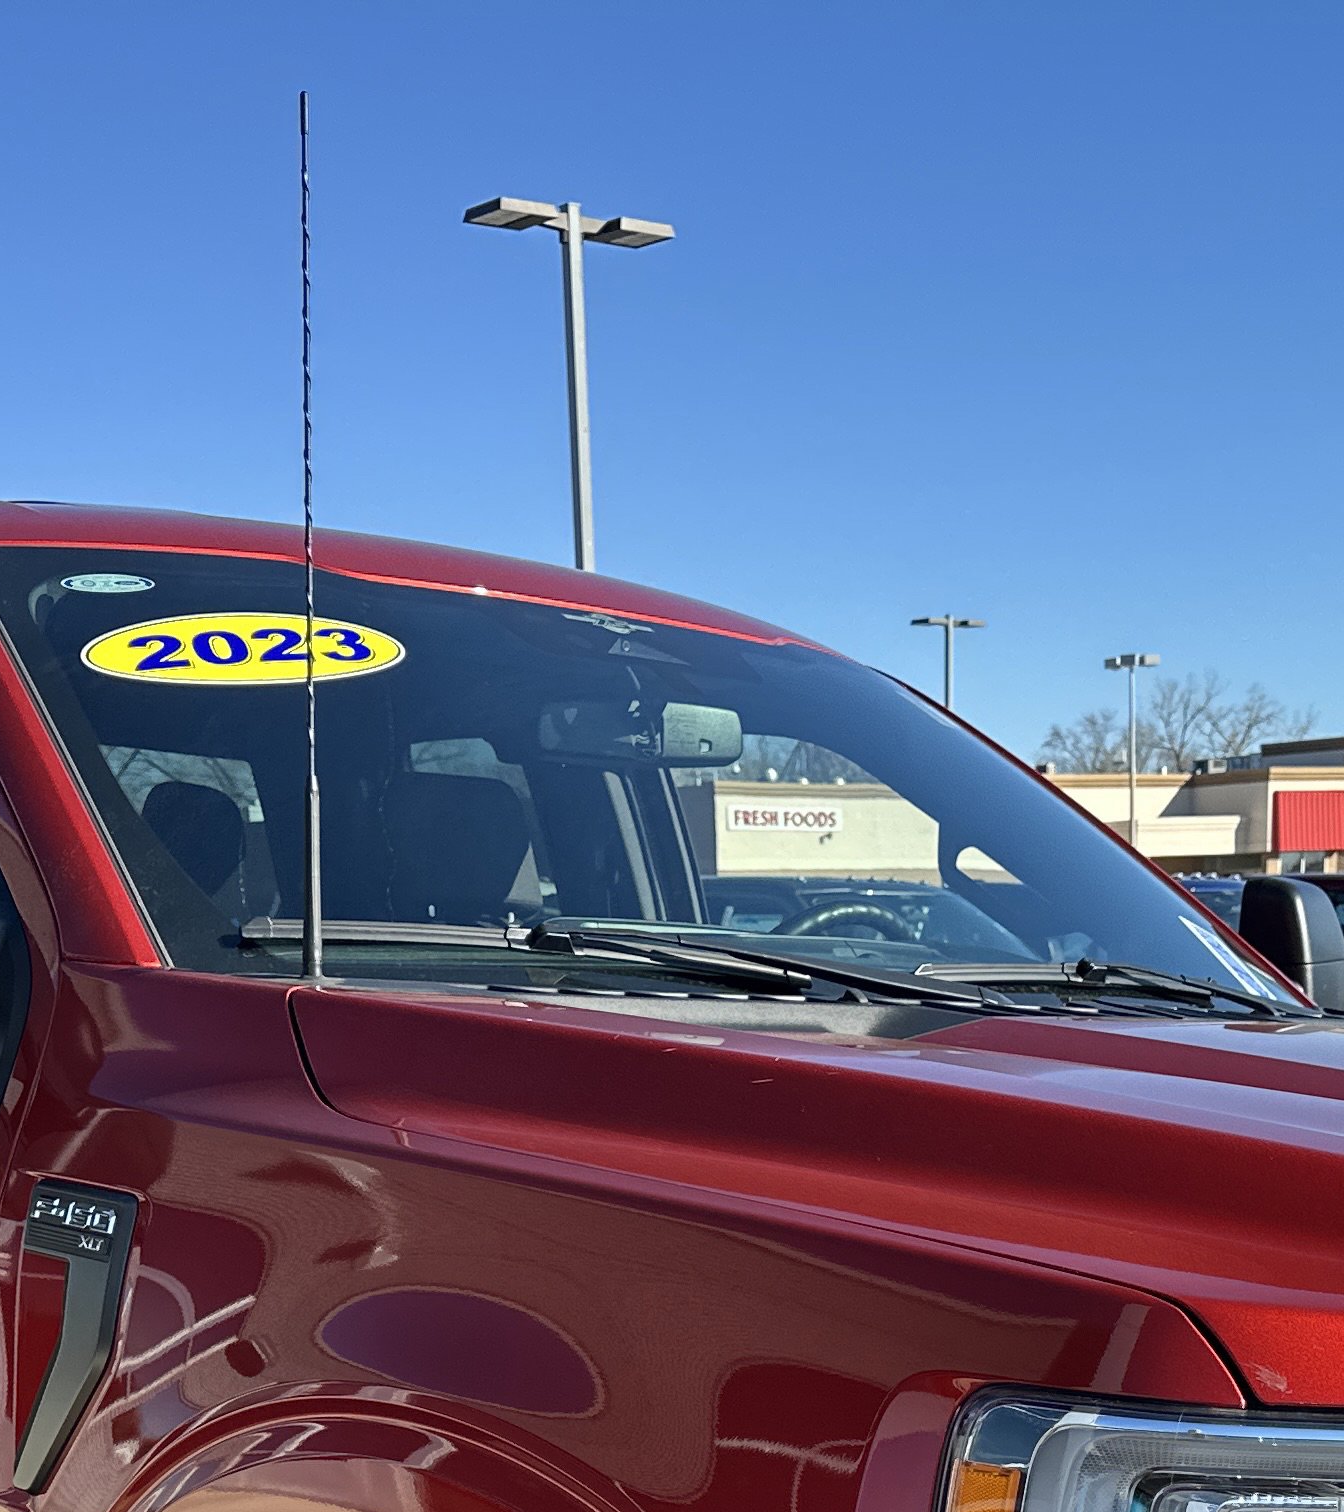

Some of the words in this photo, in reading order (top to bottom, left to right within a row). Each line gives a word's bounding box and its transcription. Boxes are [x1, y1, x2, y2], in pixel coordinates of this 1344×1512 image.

[127, 628, 375, 672] 2023
[734, 810, 778, 826] FRESH
[783, 811, 837, 827] FOODS
[30, 1198, 117, 1234] F-150
[78, 1235, 104, 1251] XLT
